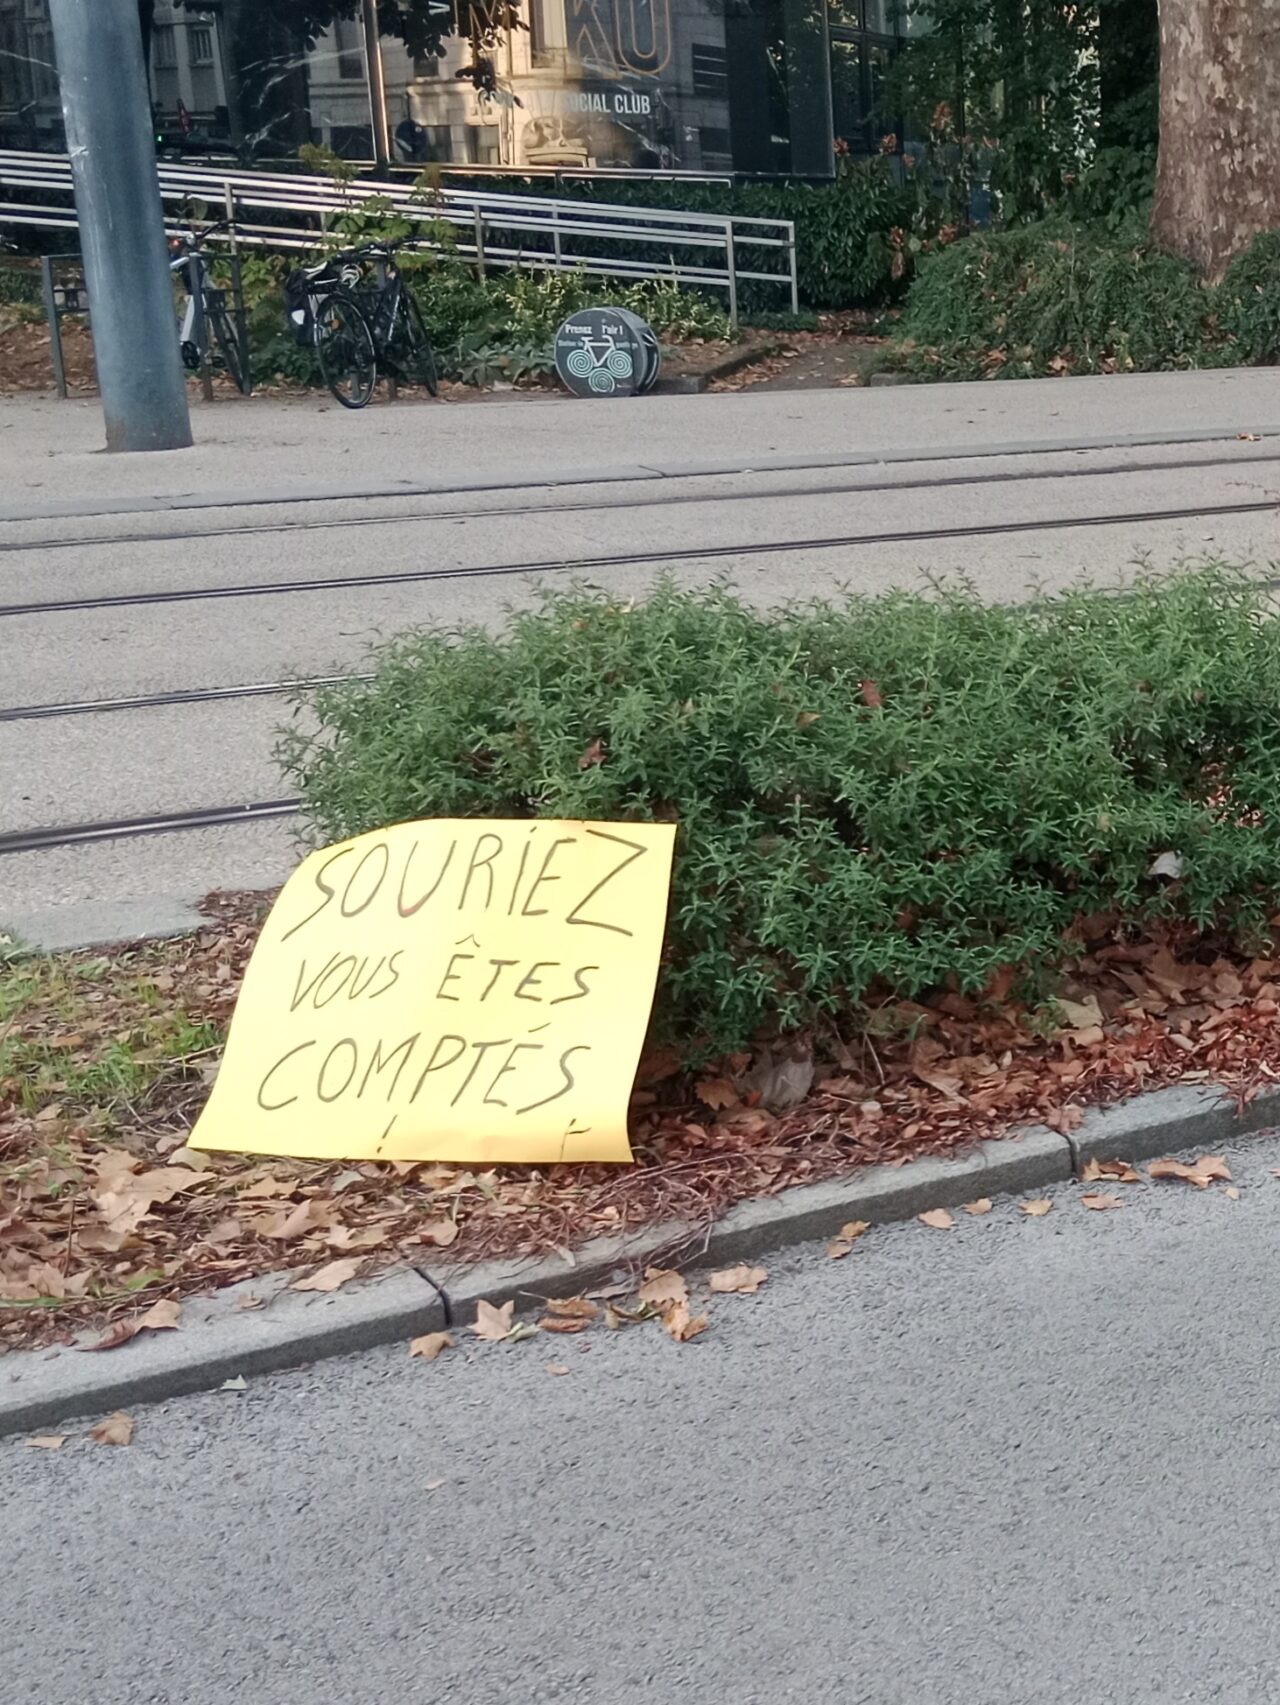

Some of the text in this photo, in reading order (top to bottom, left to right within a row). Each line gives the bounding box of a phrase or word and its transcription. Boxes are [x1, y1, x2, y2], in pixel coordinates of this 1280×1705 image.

[614, 93, 652, 115] CLUB
[290, 934, 600, 1012] VOUS ÊTES
[257, 1022, 592, 1115] COMPTÉS
